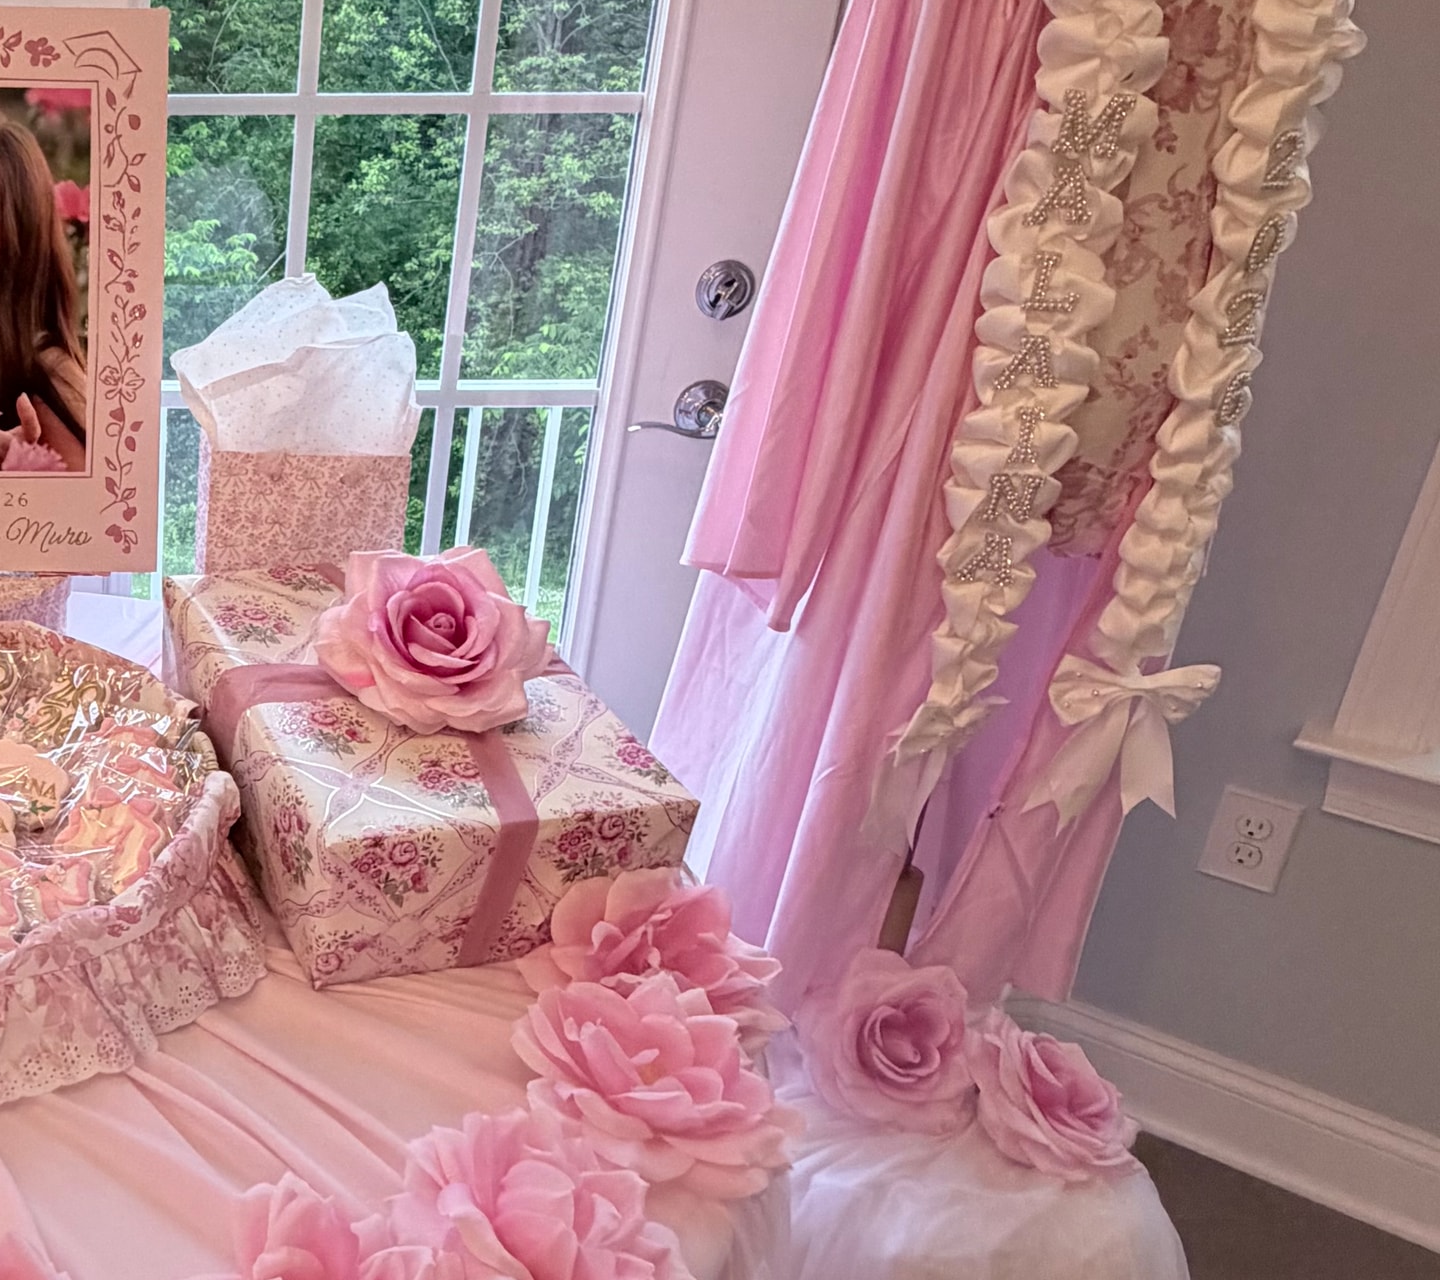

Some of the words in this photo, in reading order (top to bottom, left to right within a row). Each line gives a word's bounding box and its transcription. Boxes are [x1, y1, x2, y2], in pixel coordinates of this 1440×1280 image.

[957, 88, 1137, 587] MALAINA
[1216, 129, 1305, 426] 2026
[6, 516, 93, 553] Muro
